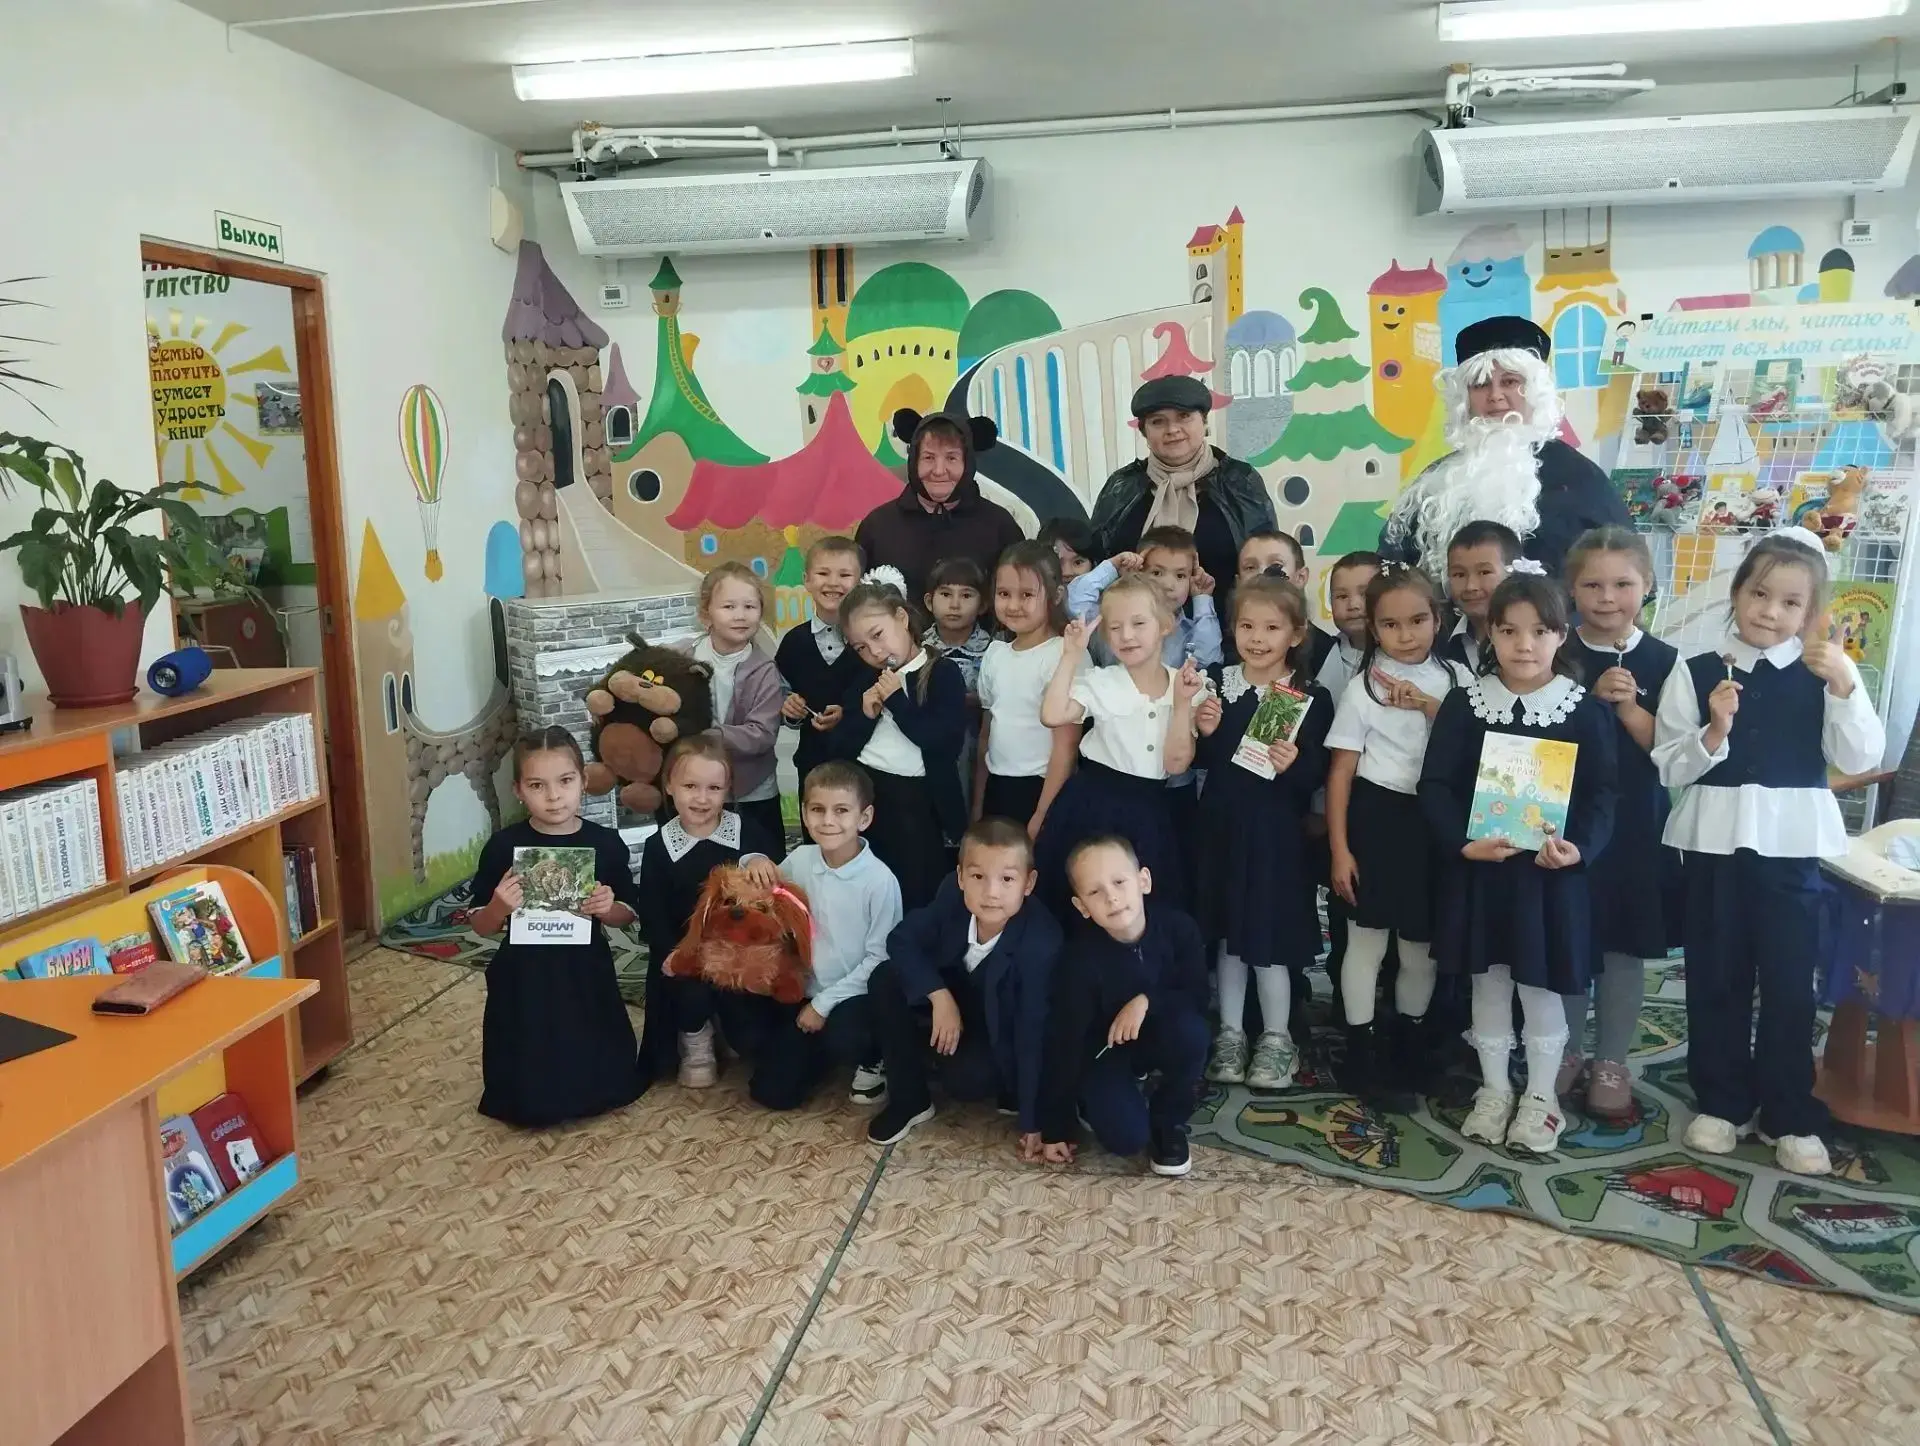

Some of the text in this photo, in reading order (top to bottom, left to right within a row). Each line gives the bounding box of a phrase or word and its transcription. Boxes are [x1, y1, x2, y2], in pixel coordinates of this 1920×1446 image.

[220, 218, 279, 253] Выход
[1641, 343, 1726, 361] читает
[1731, 340, 1769, 357] вся
[153, 385, 213, 406] сумеет
[213, 759, 225, 796] ПОЗНАЮ
[56, 816, 64, 837] МИР
[58, 839, 70, 878] ПОЗНАЮ
[527, 921, 575, 933] БОЦМАН
[47, 944, 94, 977] БАРБИ
